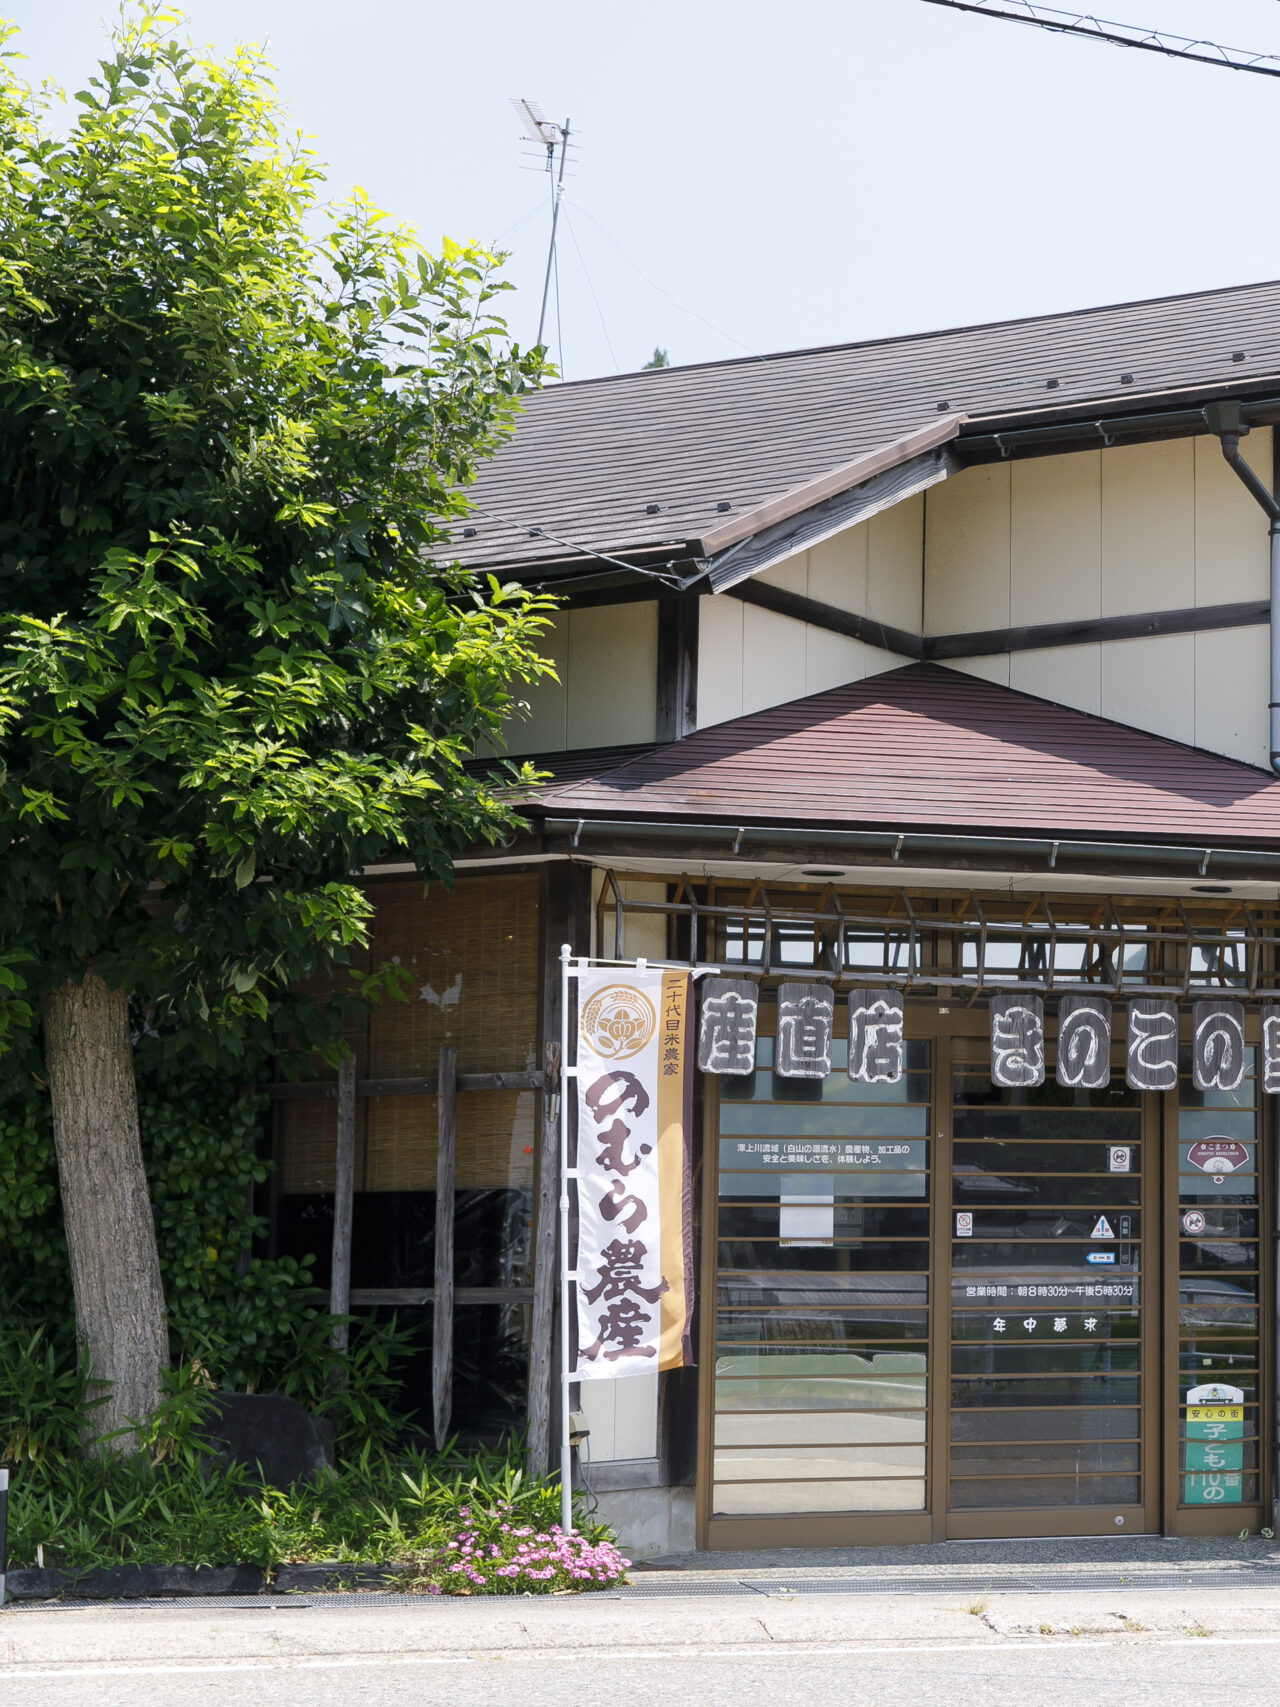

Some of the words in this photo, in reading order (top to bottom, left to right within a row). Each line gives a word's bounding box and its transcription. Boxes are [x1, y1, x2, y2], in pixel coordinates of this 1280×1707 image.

[663, 979, 681, 1076] 二十代目米農家
[699, 991, 904, 1083] 産直店
[579, 1070, 670, 1361] のむら農産
[1192, 1410, 1239, 1419] 安心の街
